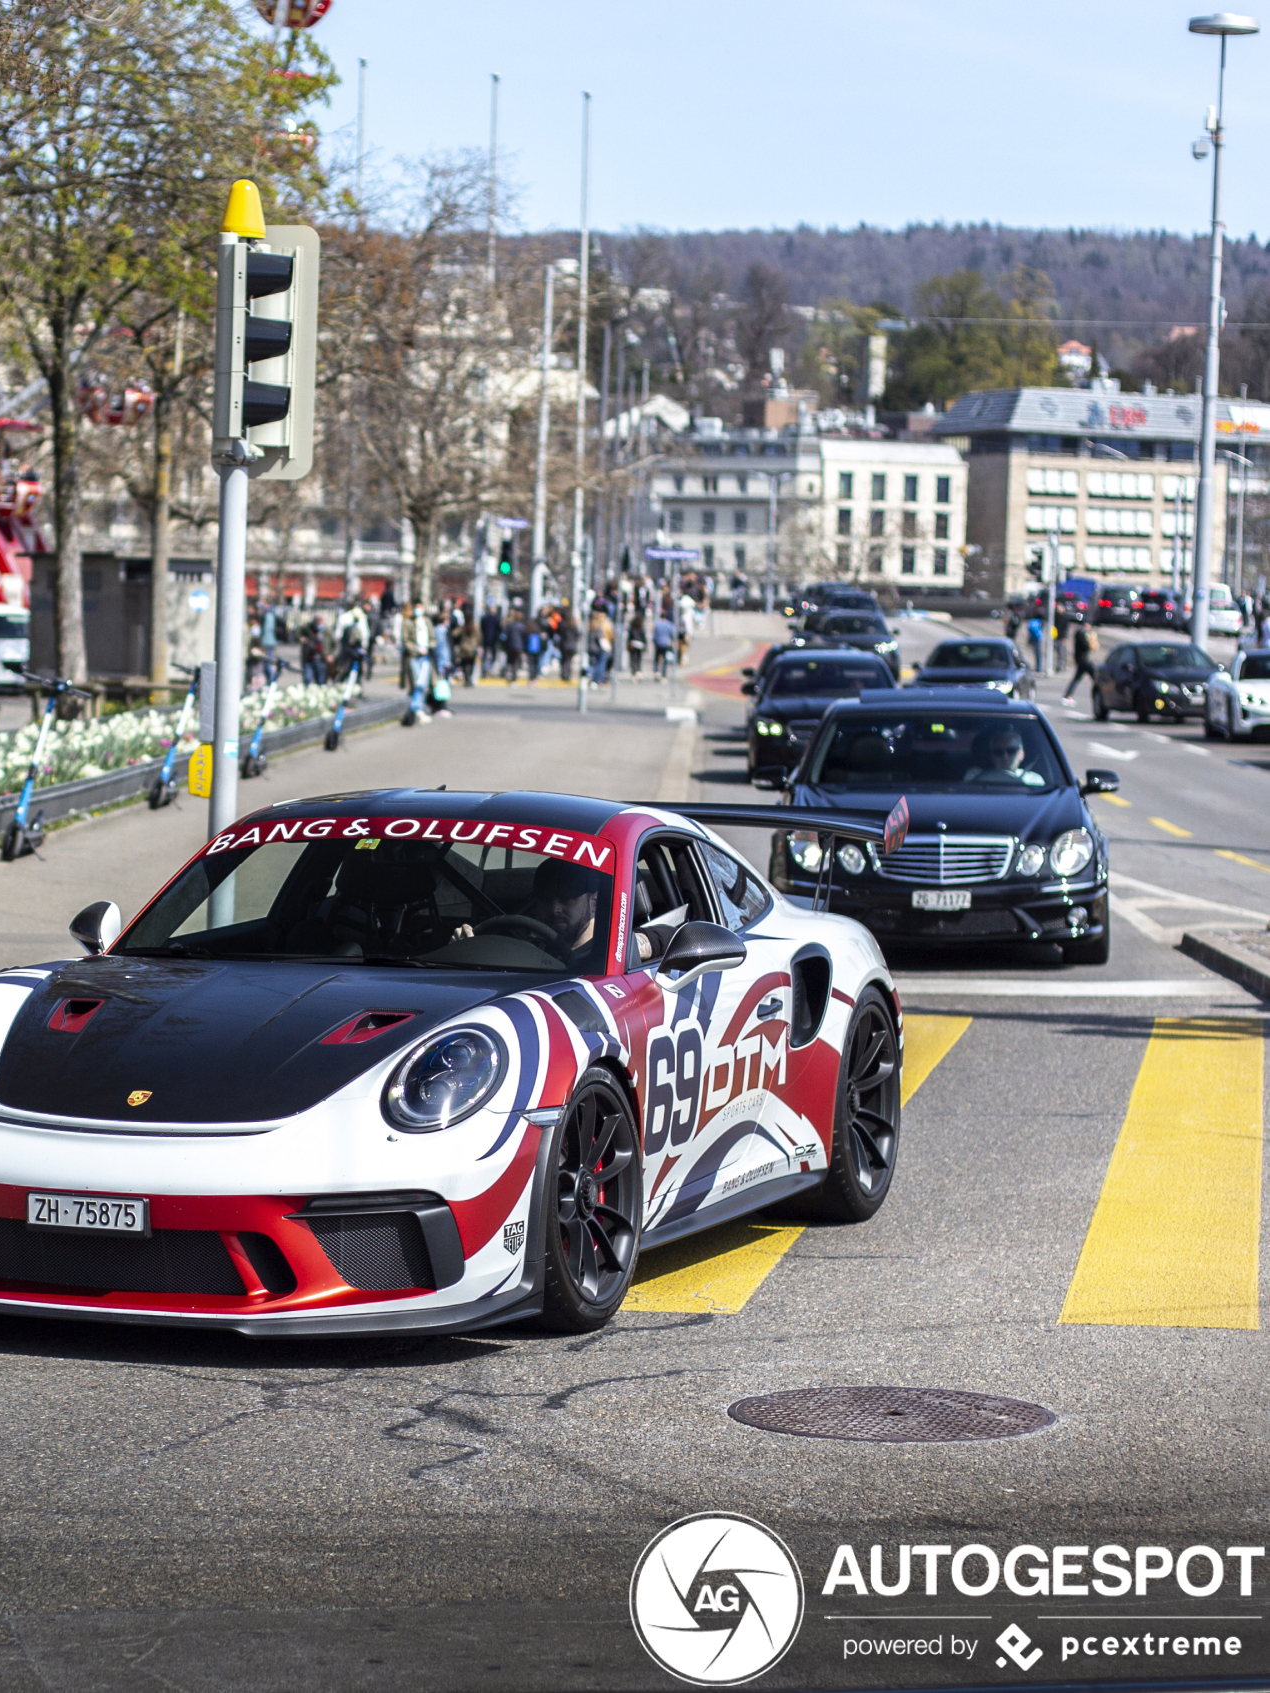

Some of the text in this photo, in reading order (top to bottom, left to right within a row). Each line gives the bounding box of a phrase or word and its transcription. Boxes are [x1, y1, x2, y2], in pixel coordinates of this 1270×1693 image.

[206, 818, 611, 868] BANG & OLUFSEN
[644, 1026, 787, 1156] 69 DTM
[722, 1093, 764, 1121] SPORTS CARS
[505, 1222, 524, 1236] TAG
[504, 1235, 524, 1254] HEUER
